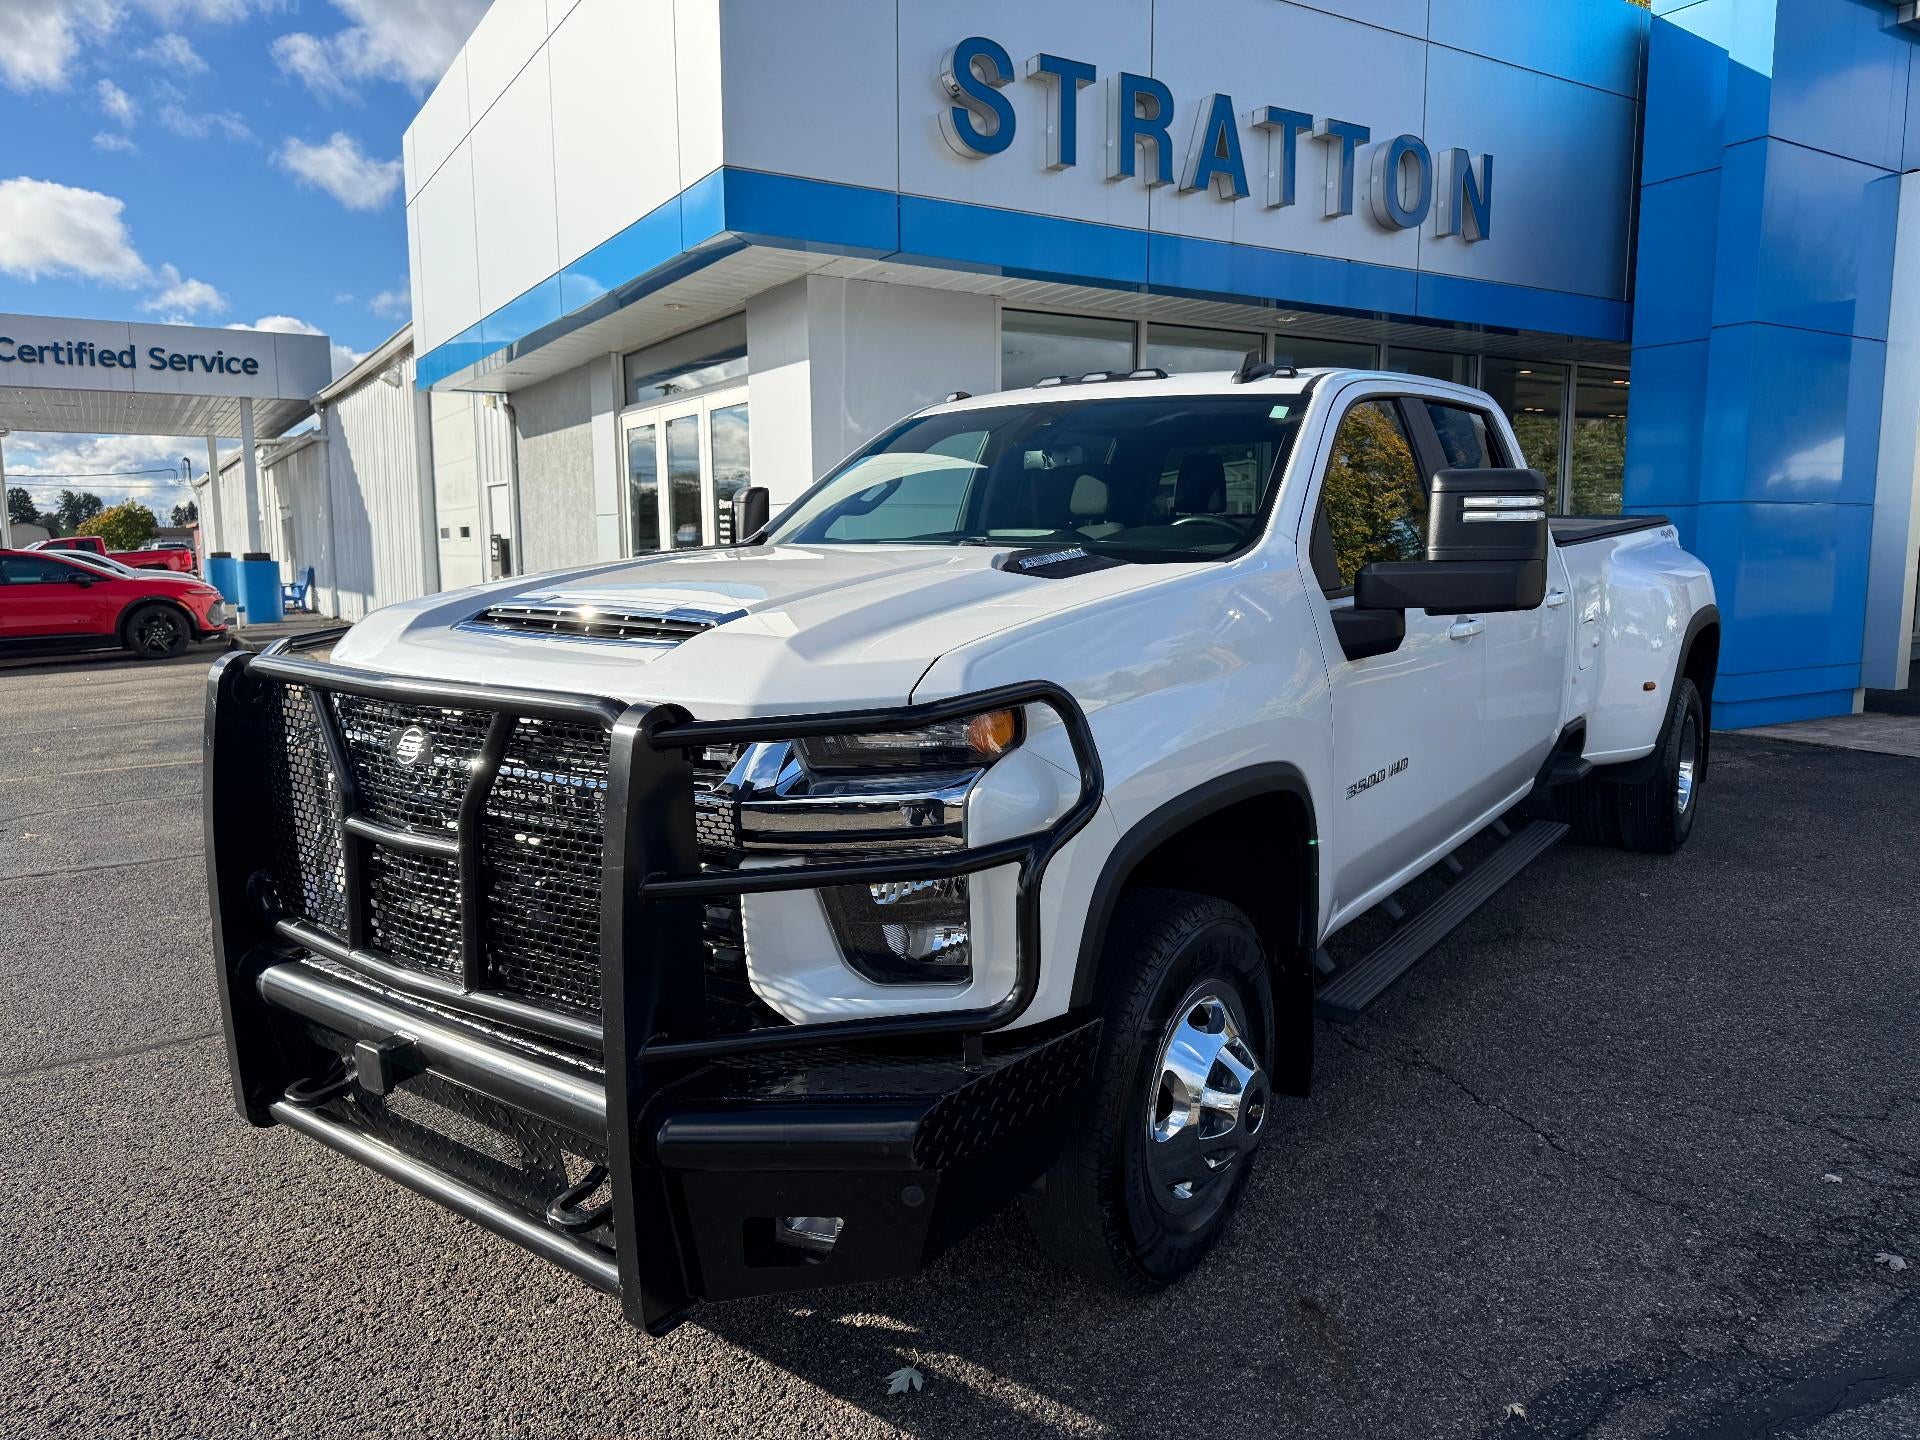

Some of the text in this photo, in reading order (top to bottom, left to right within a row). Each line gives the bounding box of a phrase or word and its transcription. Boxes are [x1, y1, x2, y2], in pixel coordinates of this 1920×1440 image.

[940, 36, 1493, 242] STRATTON
[0, 337, 259, 375] Certified Service
[1346, 757, 1409, 800] 3500 HD
